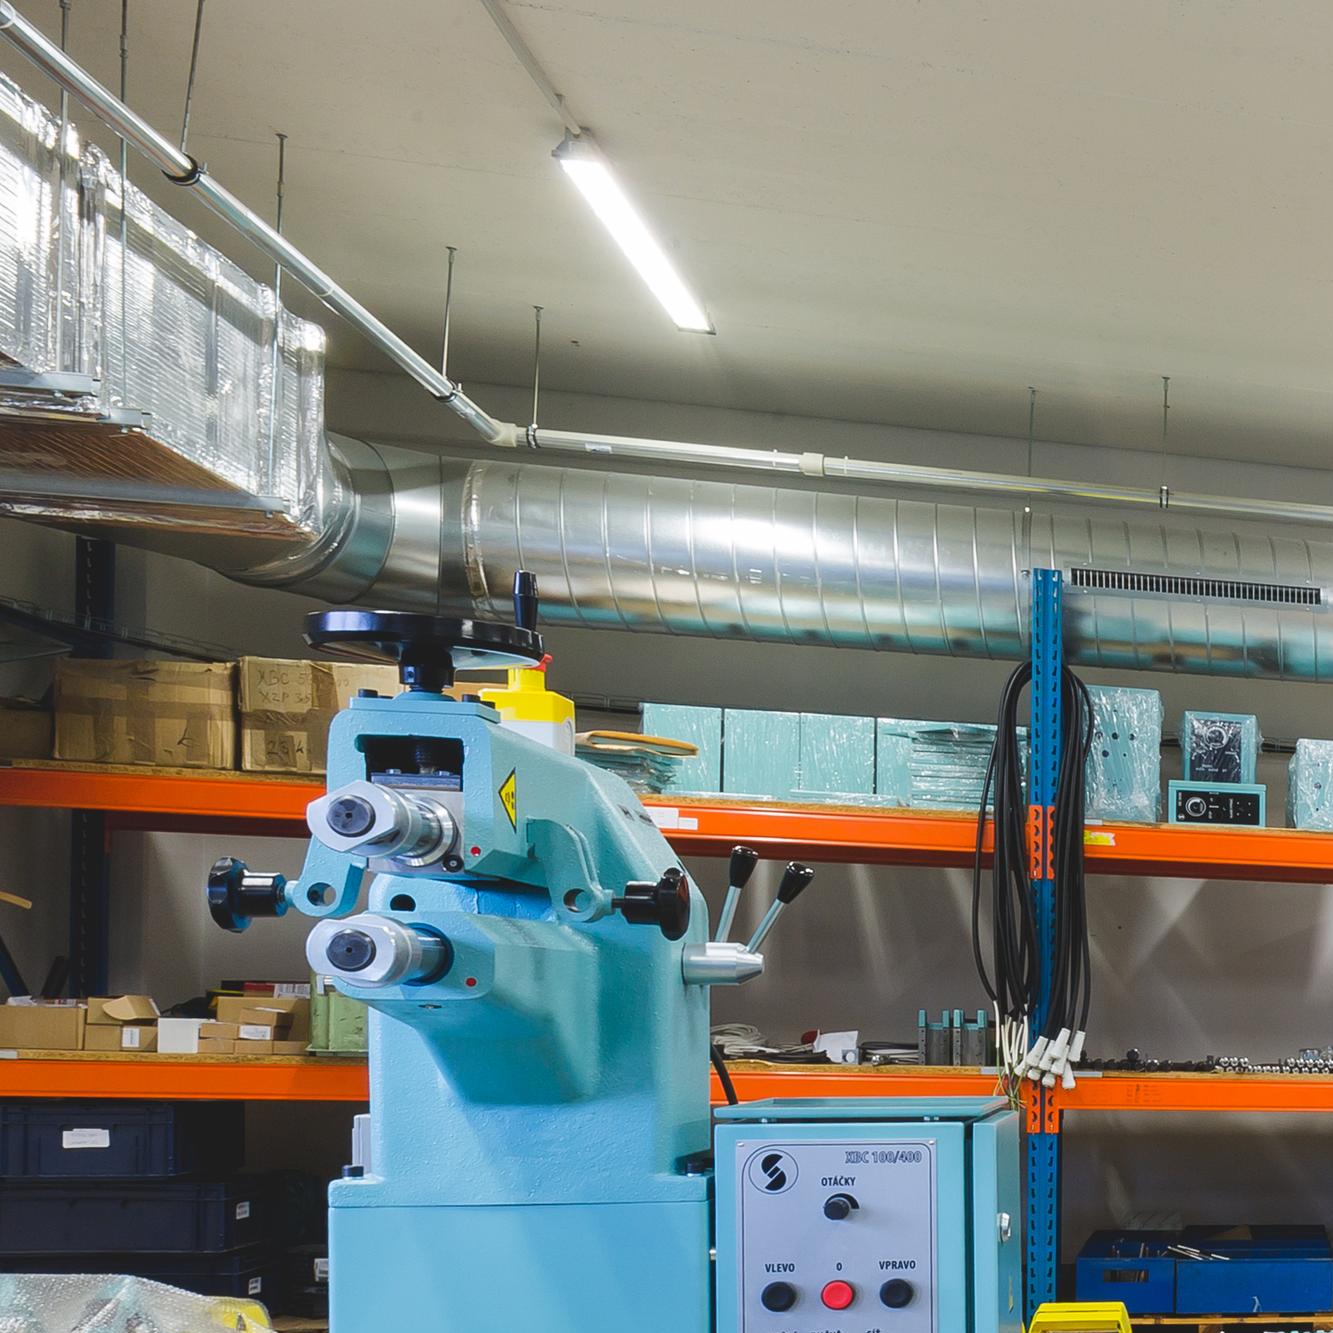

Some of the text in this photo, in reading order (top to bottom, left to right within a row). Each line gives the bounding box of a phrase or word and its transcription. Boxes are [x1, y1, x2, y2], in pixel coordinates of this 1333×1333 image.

[844, 1150, 923, 1164] XBC 100/400
[820, 1175, 857, 1187] OTÁČKY
[764, 1262, 796, 1274] VLEVO
[878, 1259, 917, 1271] VPRAVO
